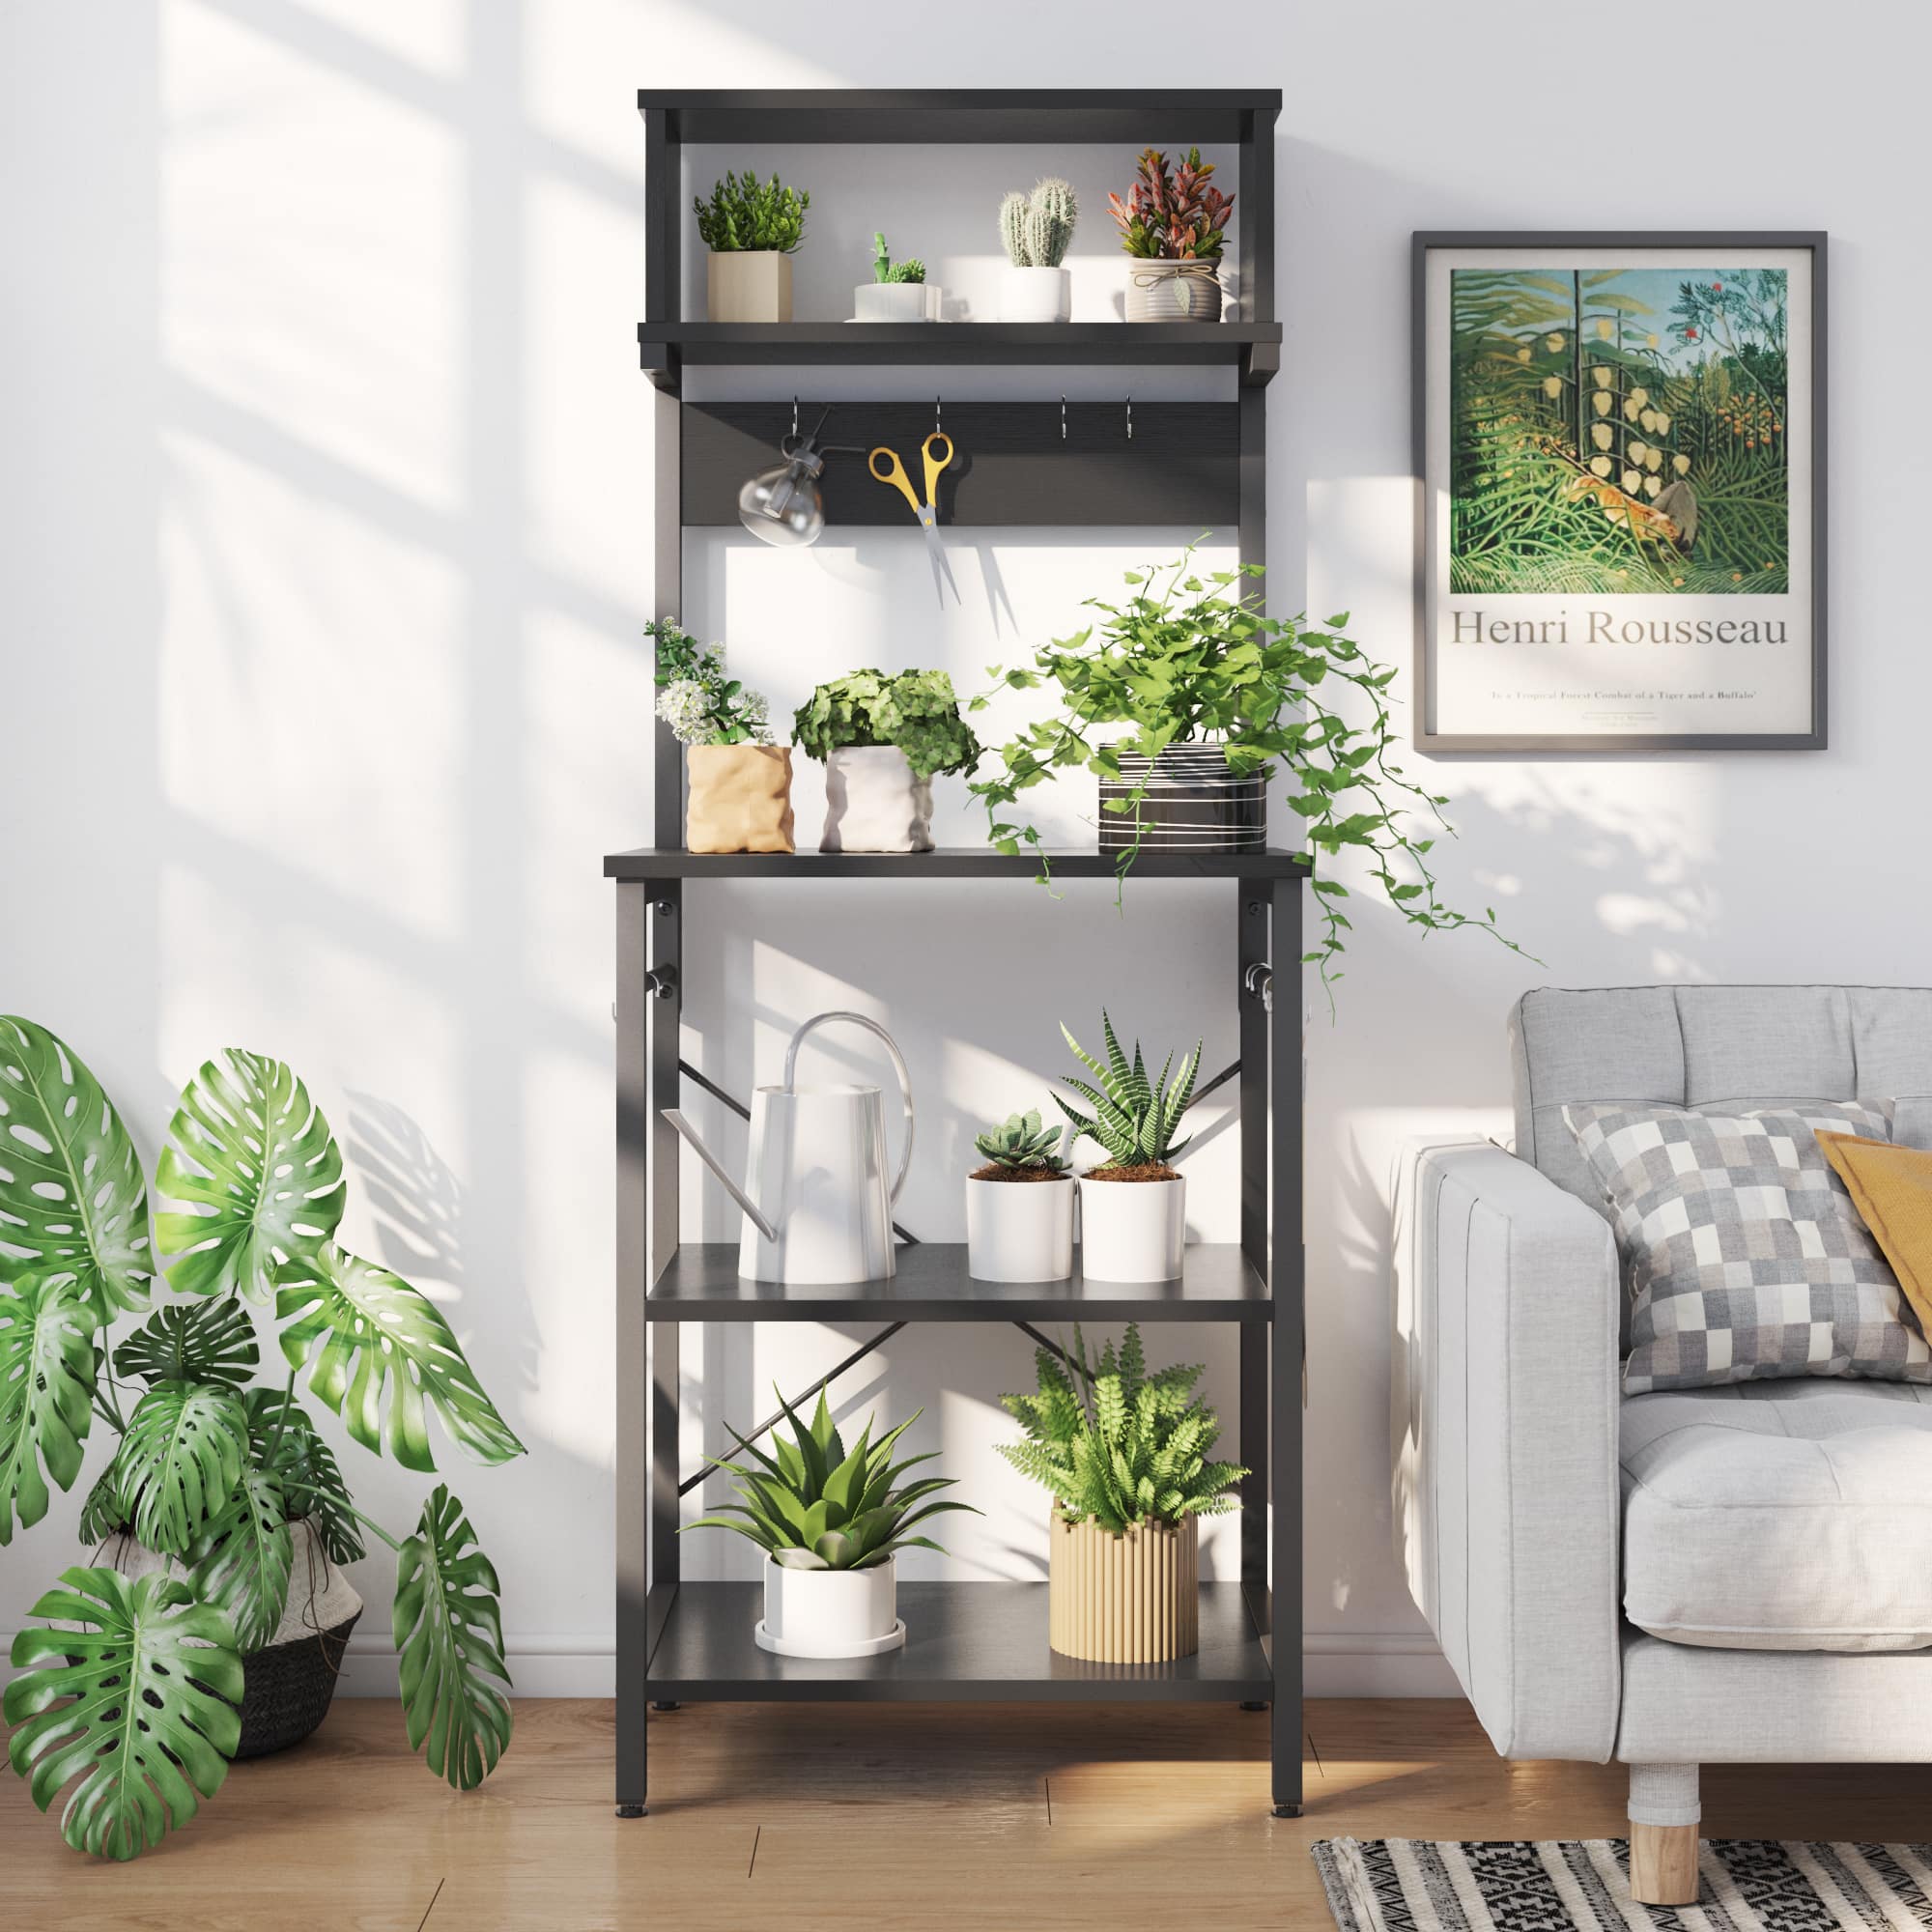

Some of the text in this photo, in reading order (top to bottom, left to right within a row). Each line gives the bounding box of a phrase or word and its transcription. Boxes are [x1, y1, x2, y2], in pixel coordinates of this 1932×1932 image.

[1450, 610, 1789, 644] Henri Rousseau
[1560, 691, 1591, 699] Forest
[1594, 691, 1631, 699] Combat
[1658, 691, 1684, 701] Tiger
[1688, 691, 1705, 699] and
